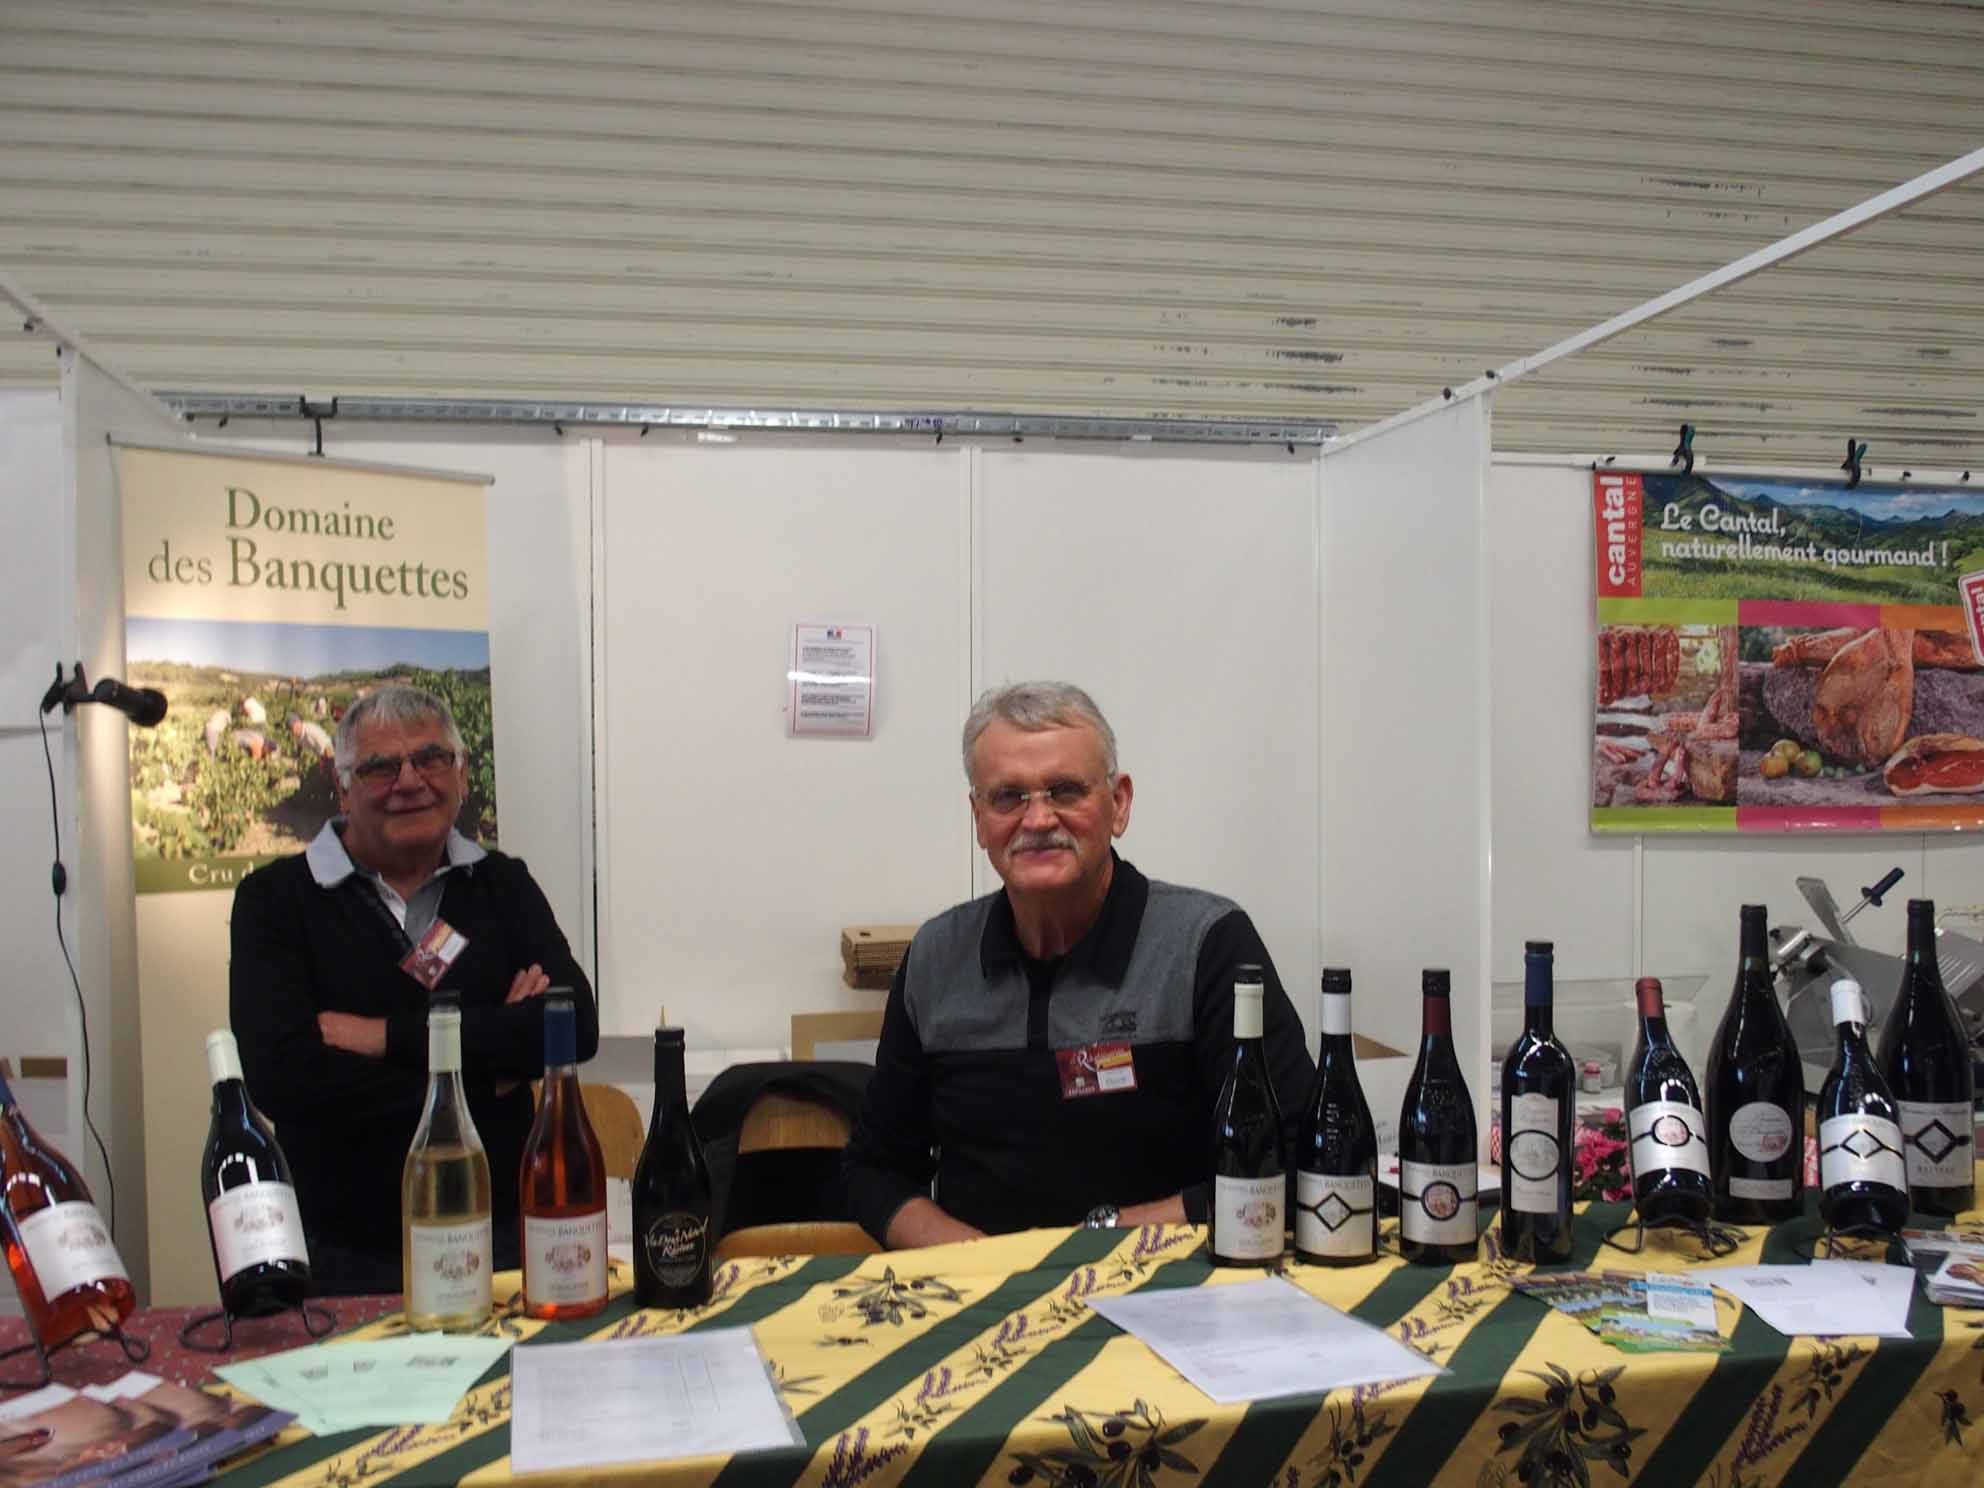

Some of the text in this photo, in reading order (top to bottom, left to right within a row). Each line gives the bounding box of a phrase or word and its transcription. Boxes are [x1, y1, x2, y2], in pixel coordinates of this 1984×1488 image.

[225, 487, 396, 539] Domaine
[1600, 476, 1626, 586] cantal
[1626, 475, 1638, 587] AUVERGNE
[1660, 503, 1786, 534] Le Cantal,
[148, 536, 469, 609] des Banquettes
[1661, 535, 1815, 563] naturellement
[1823, 541, 1937, 569] gourmand
[188, 863, 232, 884] Cru
